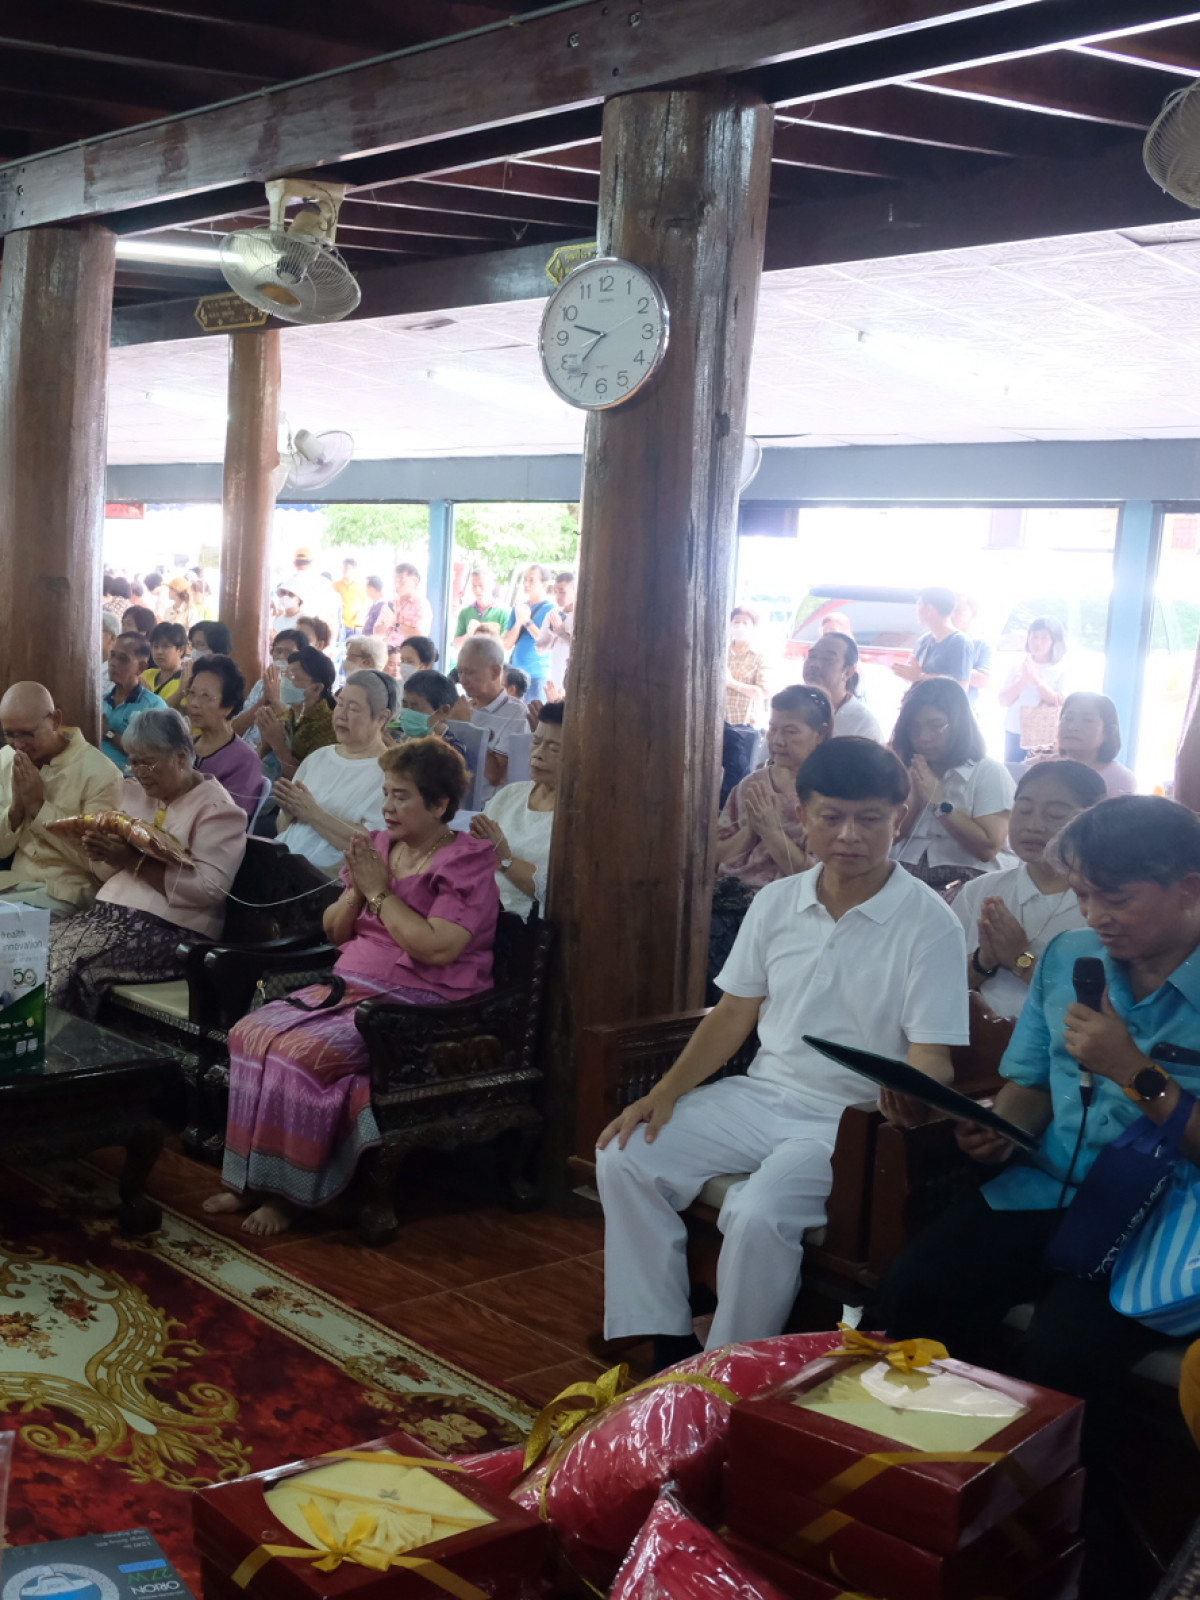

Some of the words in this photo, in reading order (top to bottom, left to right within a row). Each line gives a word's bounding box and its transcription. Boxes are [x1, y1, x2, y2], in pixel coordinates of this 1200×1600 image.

[580, 283, 591, 300] 11
[599, 275, 615, 293] 12
[626, 279, 632, 295] 1
[562, 305, 578, 321] 10
[637, 296, 650, 314] 2
[556, 330, 570, 346] 9
[641, 323, 655, 340] 3
[633, 349, 645, 366] 4
[578, 372, 589, 389] 7
[595, 377, 608, 394] 6
[616, 370, 629, 387] 5
[1, 929, 26, 939] health
